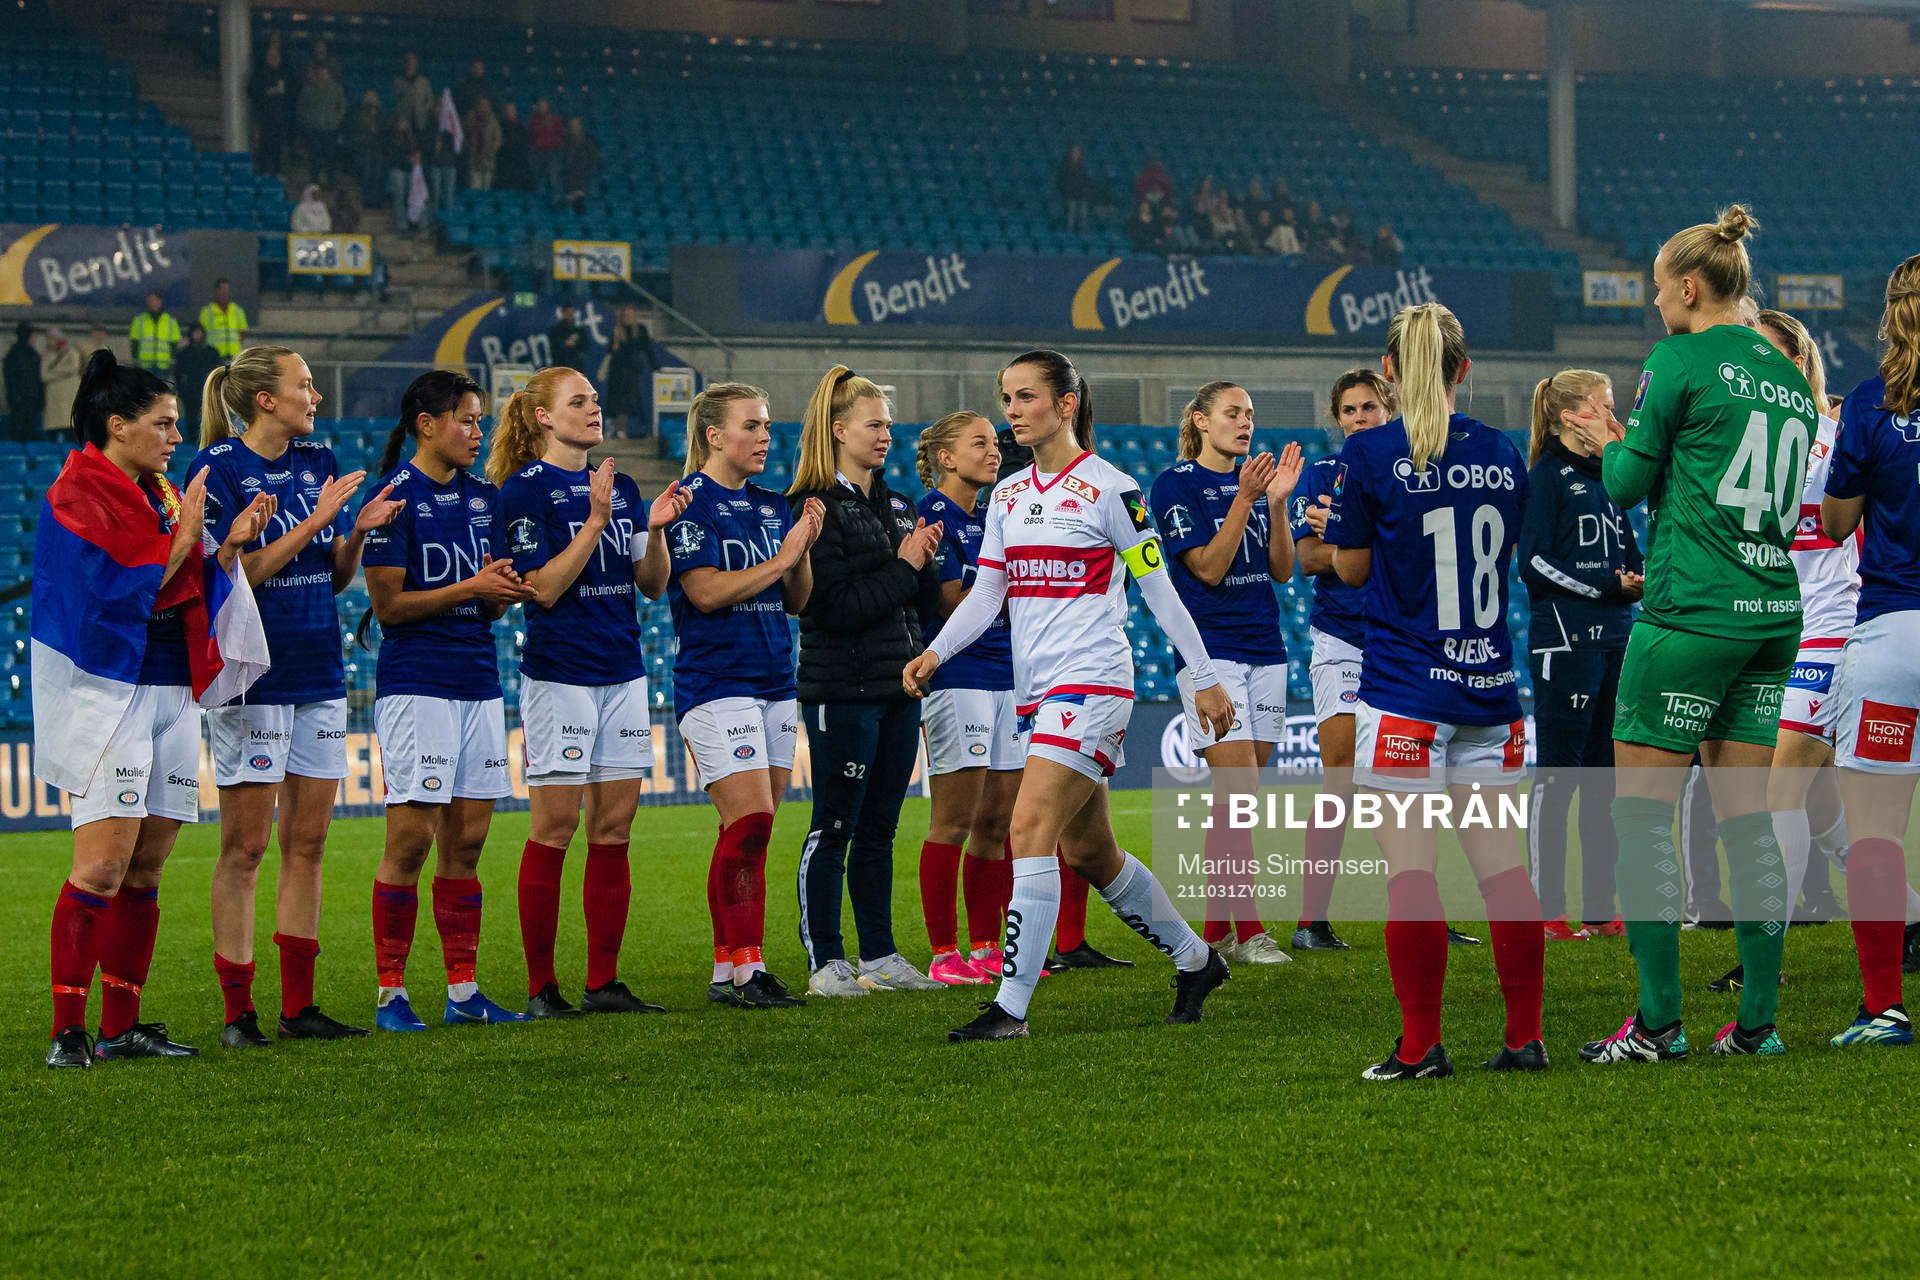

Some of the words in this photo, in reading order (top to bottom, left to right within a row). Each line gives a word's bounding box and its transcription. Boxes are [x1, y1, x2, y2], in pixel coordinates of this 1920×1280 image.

[38, 228, 171, 303] Bendit
[863, 253, 970, 322] Bendit
[1108, 260, 1209, 327] Bendit
[1341, 265, 1437, 334] Bendit
[1760, 380, 1815, 420] OBOS
[1447, 464, 1515, 490] OBOS
[1716, 410, 1809, 538] 40
[996, 482, 1028, 501] BA
[1062, 477, 1096, 503] BA
[1024, 517, 1044, 525] OBOS
[1142, 542, 1160, 568] C
[1423, 504, 1504, 631] 18
[1733, 598, 1764, 613] mot
[1588, 625, 1603, 640] 17
[1430, 667, 1464, 684] mot
[1571, 693, 1589, 709] 17
[1661, 692, 1720, 719] THON
[1663, 715, 1708, 732] HOTELS
[1864, 720, 1911, 736] THON
[1377, 734, 1425, 752] THON
[1867, 735, 1904, 745] HOTELS
[1384, 751, 1420, 761] HOTELS
[844, 762, 866, 779] 32
